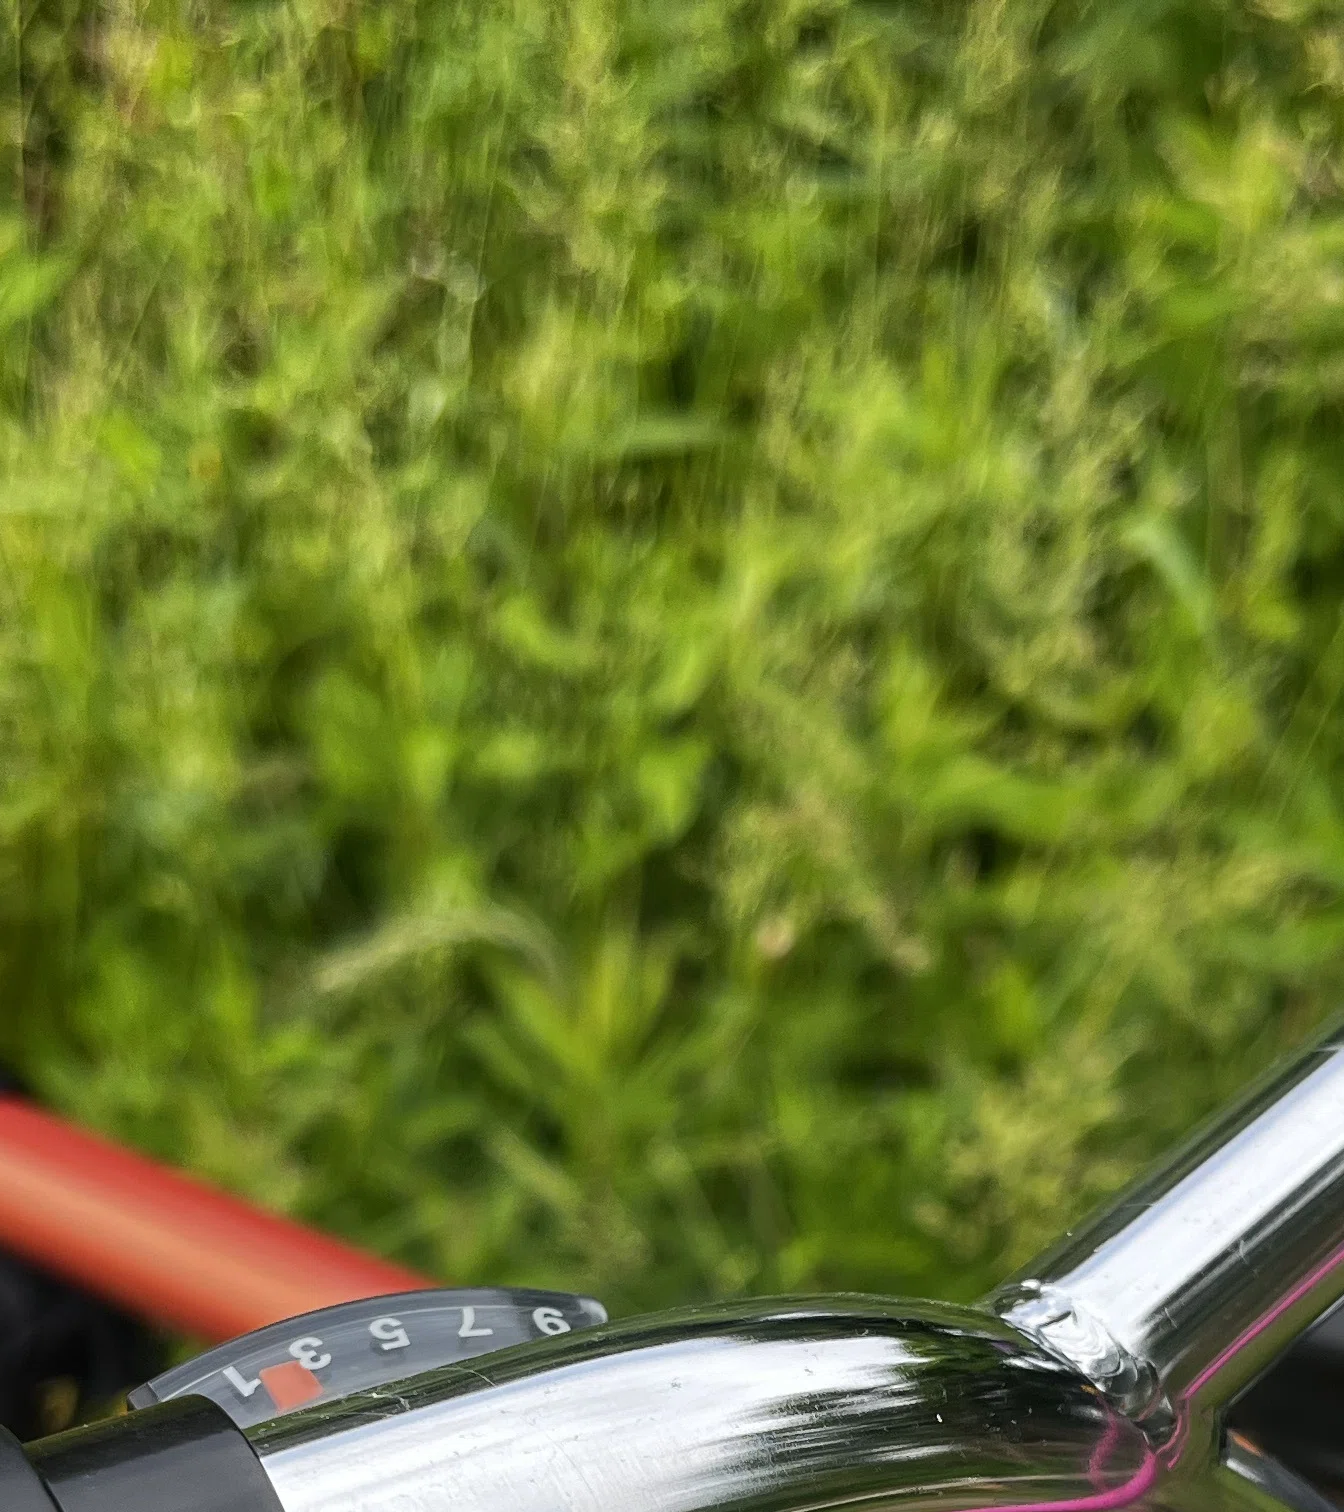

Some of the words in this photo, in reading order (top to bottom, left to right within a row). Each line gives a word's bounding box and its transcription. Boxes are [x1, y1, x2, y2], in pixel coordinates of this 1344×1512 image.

[368, 1317, 411, 1352] 5
[457, 1306, 494, 1338] 7
[532, 1306, 571, 1336] 9
[288, 1336, 332, 1370] 3
[222, 1365, 262, 1397] 1
